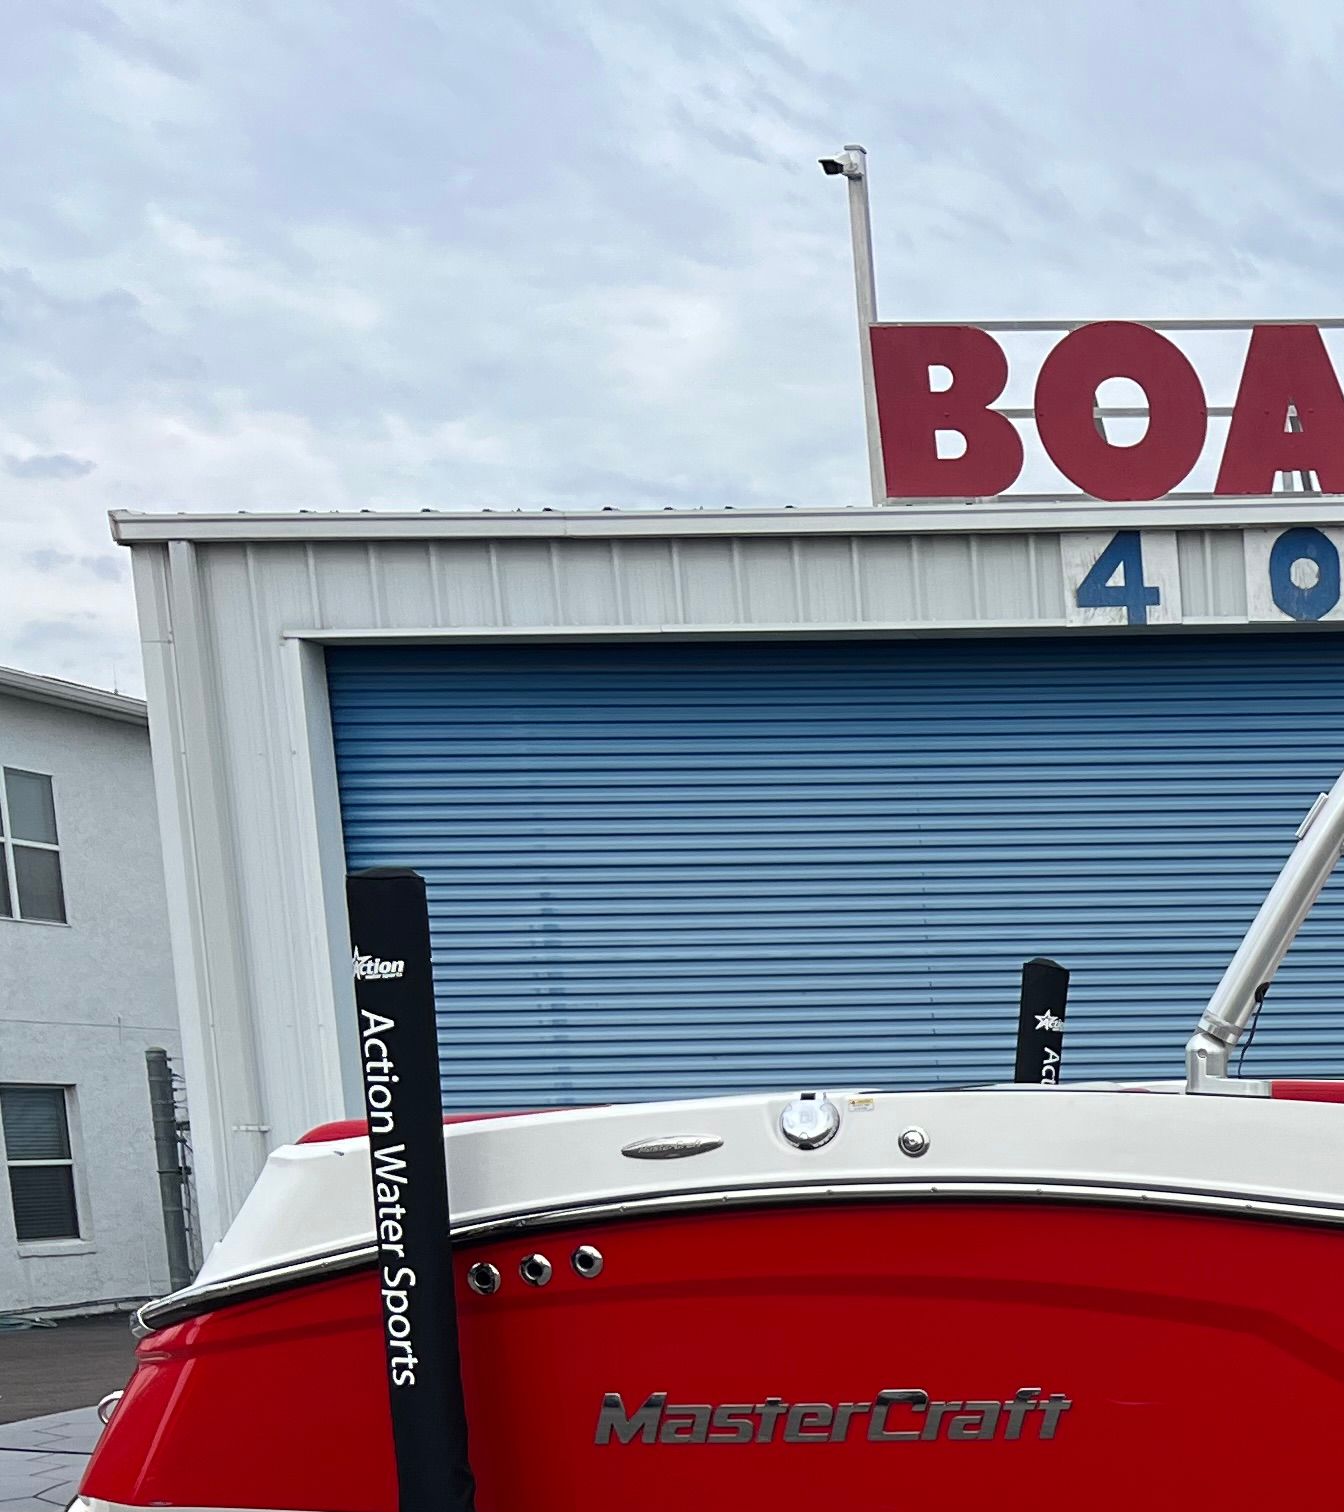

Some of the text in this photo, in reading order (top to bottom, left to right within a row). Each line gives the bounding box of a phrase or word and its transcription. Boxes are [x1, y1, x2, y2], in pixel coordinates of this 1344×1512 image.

[360, 1008, 400, 1134] Action
[373, 1143, 408, 1258] Water
[381, 1265, 419, 1386] Sports
[594, 1387, 1073, 1445] MasterCraft
